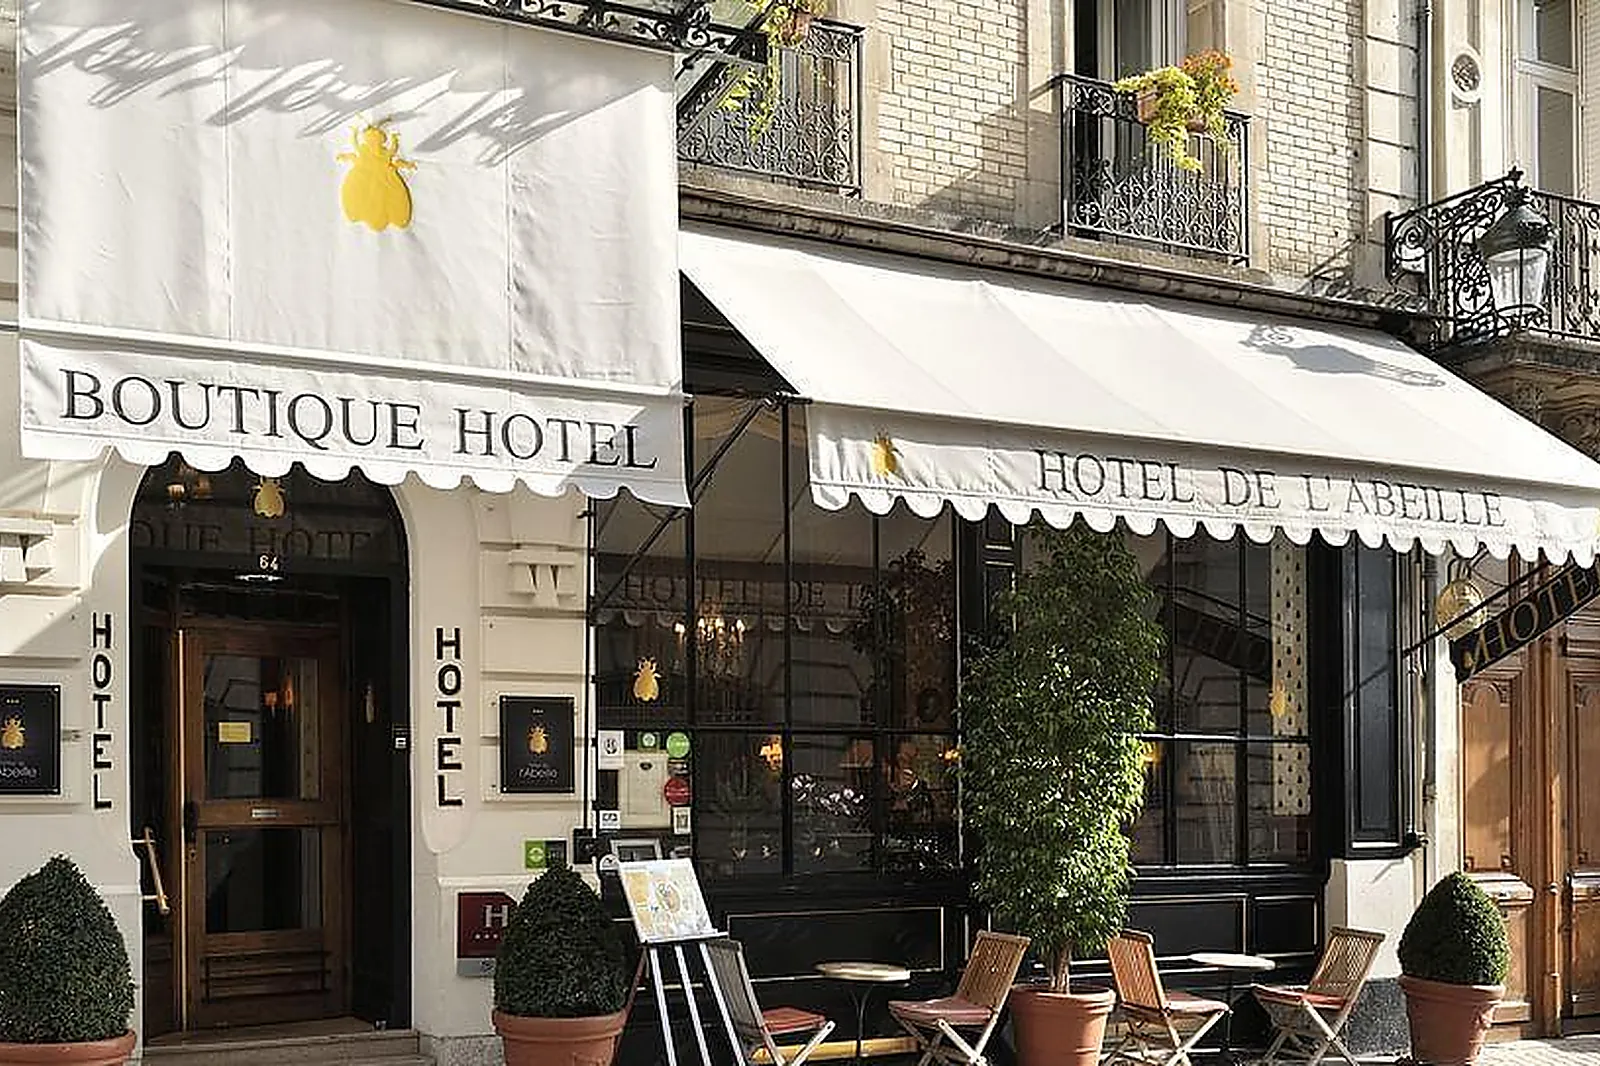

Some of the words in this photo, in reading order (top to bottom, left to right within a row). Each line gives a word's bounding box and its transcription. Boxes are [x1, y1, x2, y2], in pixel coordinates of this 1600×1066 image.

[59, 368, 424, 451] BOUTIQUE
[453, 406, 659, 470] HOTEL
[1031, 449, 1195, 503] HOTEL
[1217, 466, 1282, 509] DE
[259, 554, 278, 570] 64
[1476, 566, 1597, 663] HOTE
[92, 612, 112, 810] HOTEL
[435, 627, 464, 807] HOTEL
[484, 904, 509, 928] H
